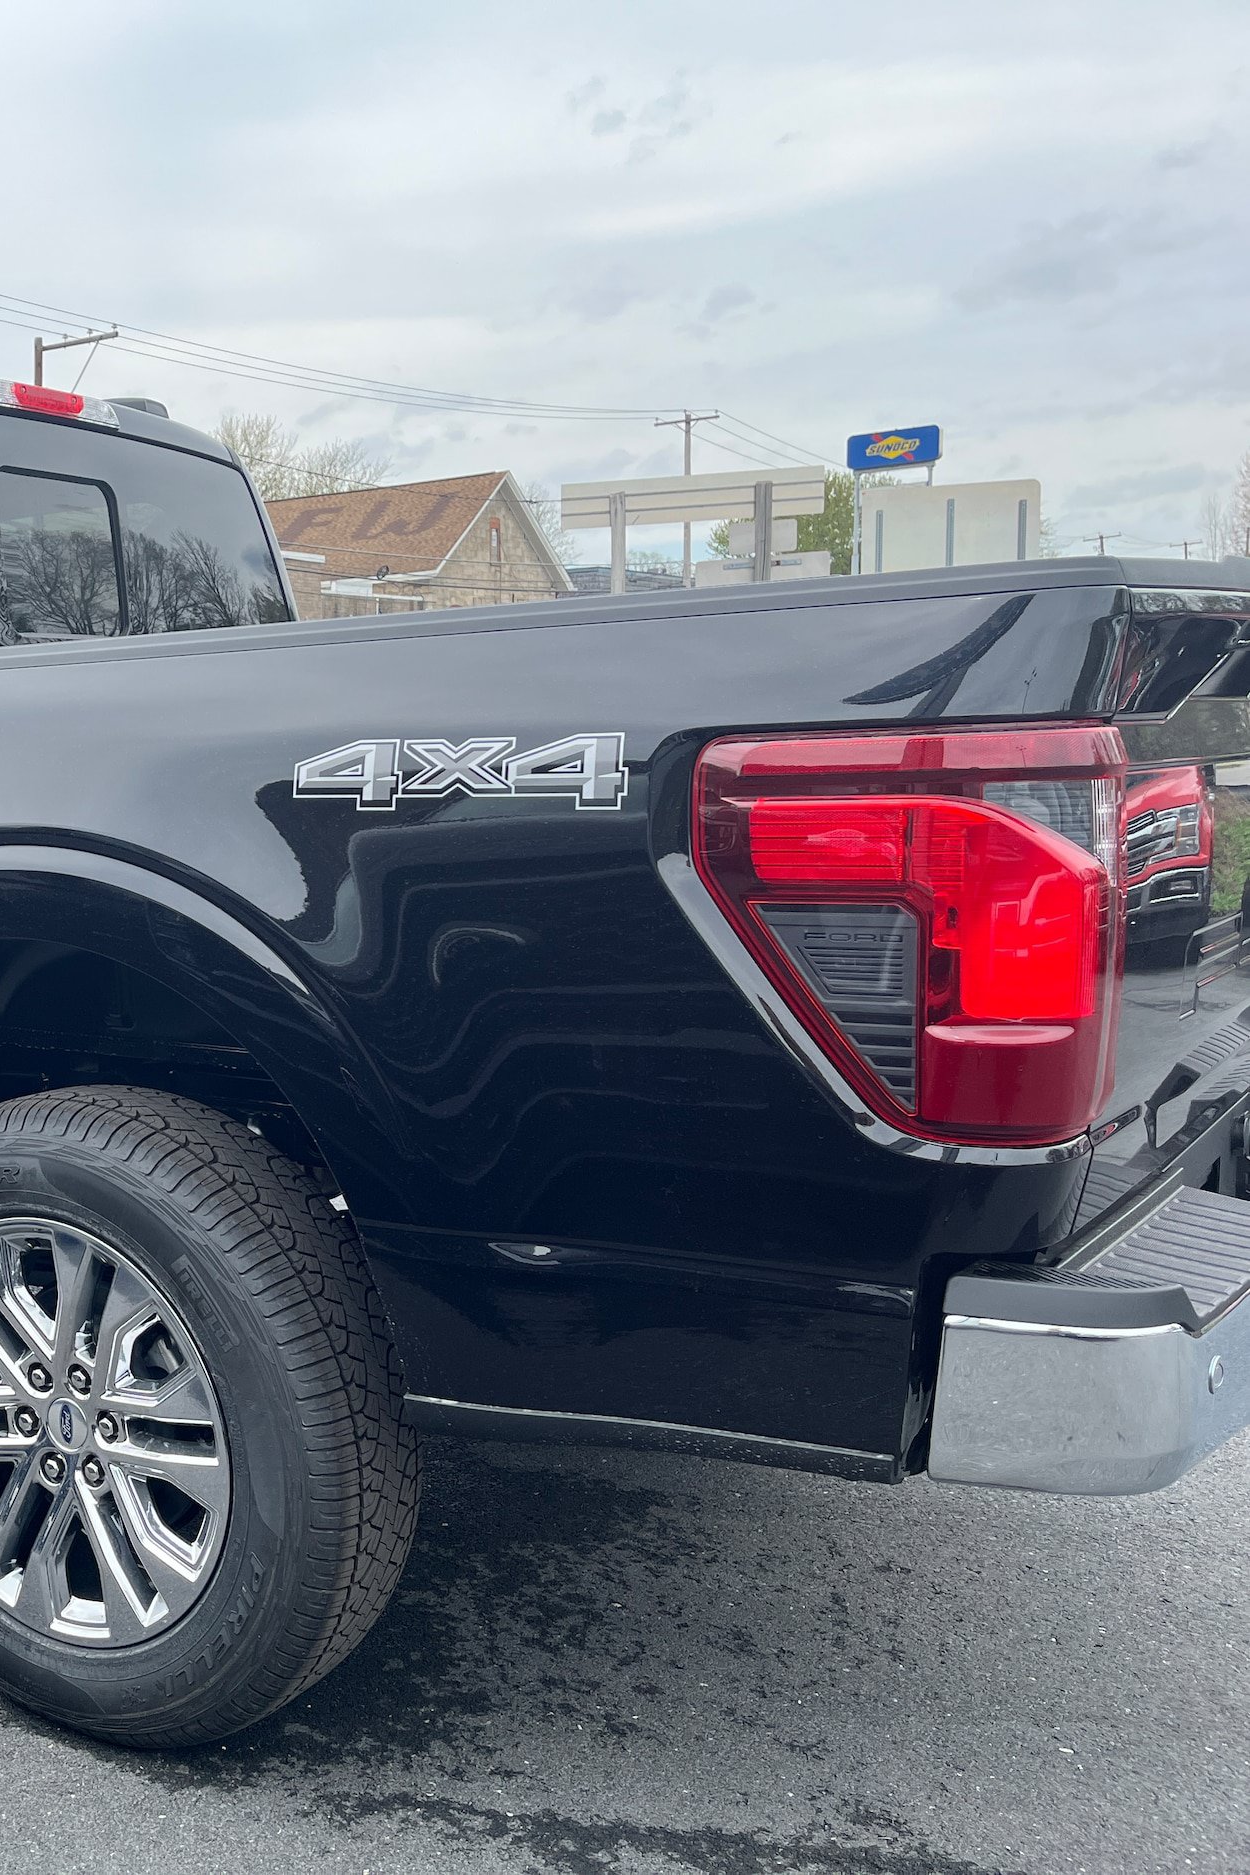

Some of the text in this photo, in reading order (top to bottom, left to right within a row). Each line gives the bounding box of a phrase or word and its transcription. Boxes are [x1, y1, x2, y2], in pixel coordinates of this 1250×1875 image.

[868, 440, 917, 455] SUNOCO
[803, 932, 904, 943] FORD
[170, 1254, 241, 1354] PIRELLI
[164, 1551, 265, 1697] PIRELLI
